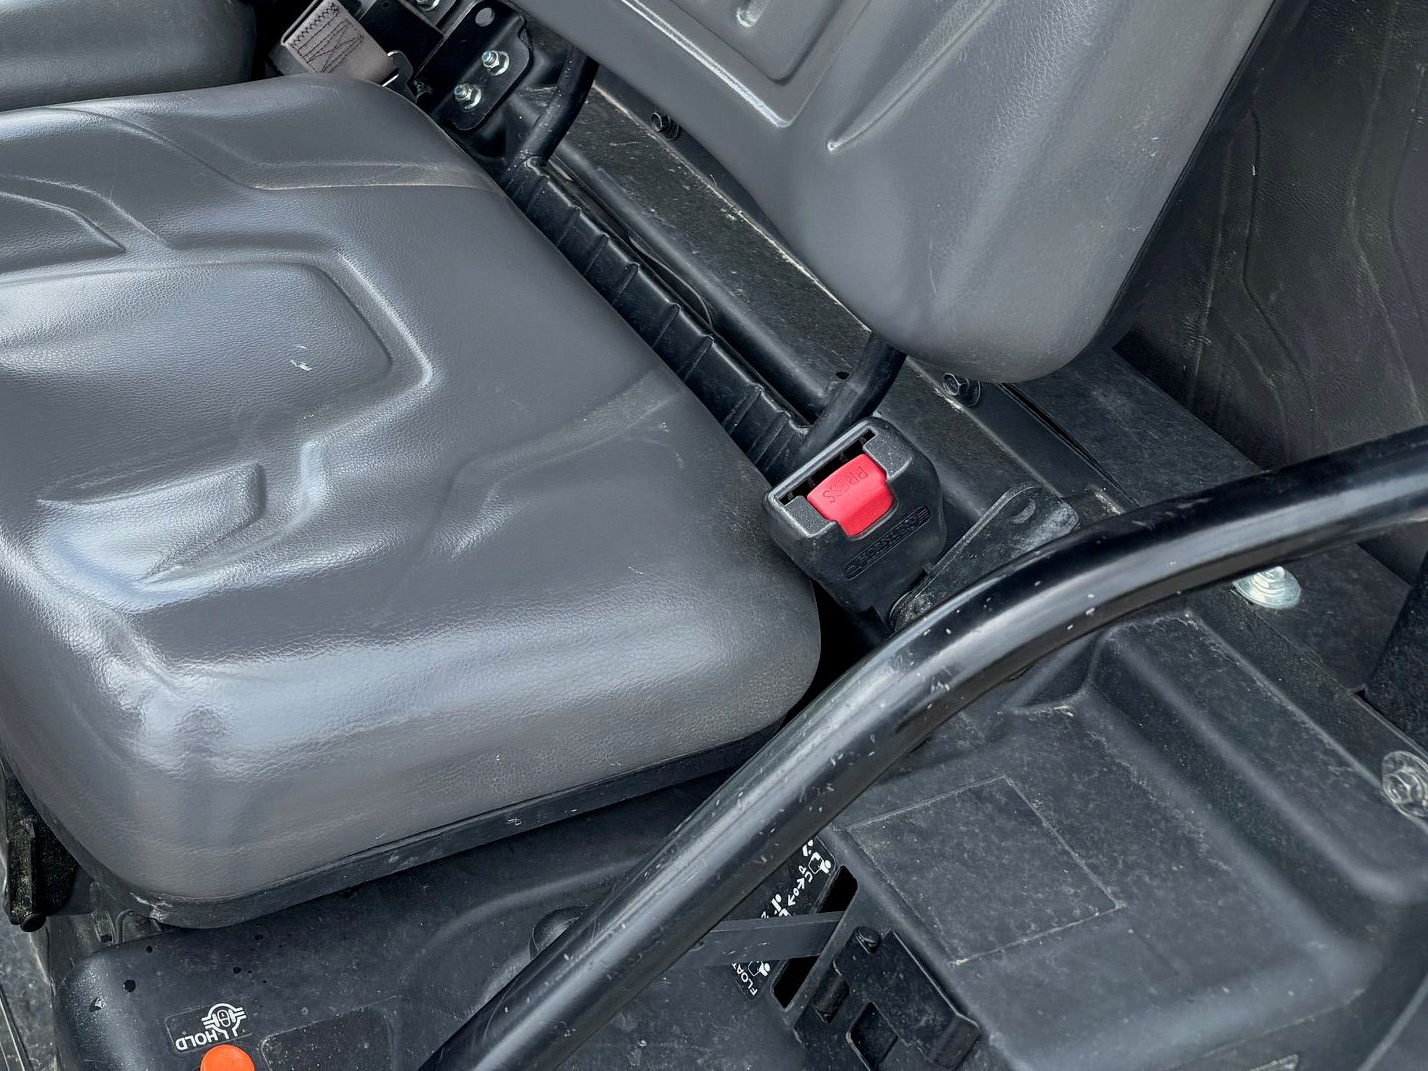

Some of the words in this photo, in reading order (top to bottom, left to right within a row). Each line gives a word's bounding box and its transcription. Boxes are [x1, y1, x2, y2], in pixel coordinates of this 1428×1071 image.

[822, 466, 869, 504] PRESS
[798, 865, 813, 883] UP
[732, 962, 758, 996] FLOAT
[175, 1030, 218, 1051] HOLD
